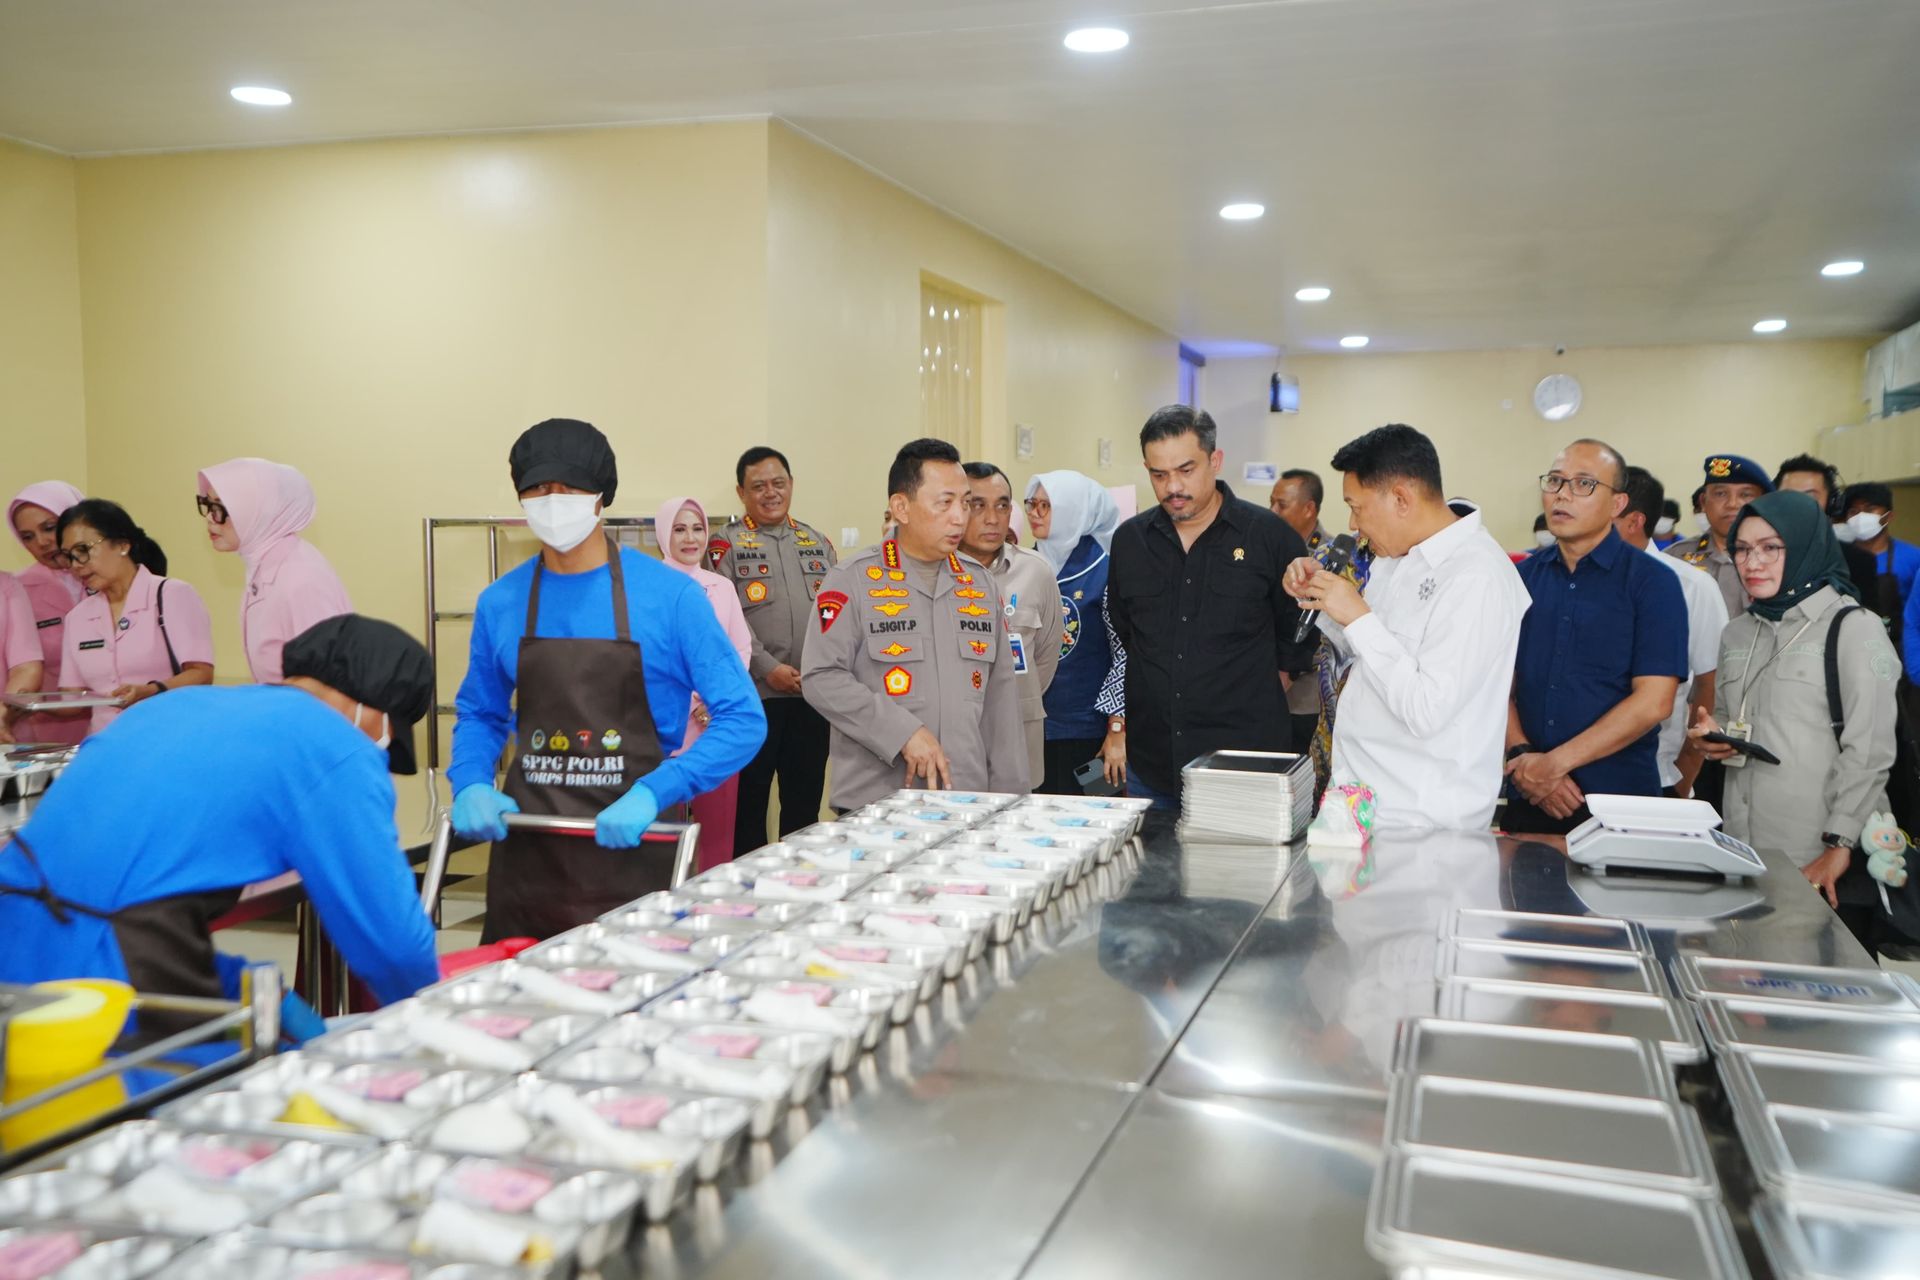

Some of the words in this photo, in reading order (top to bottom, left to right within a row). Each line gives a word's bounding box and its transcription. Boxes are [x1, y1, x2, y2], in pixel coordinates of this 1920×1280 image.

[798, 549, 825, 557] POLRI
[870, 620, 917, 634] L.SIGIT.P
[960, 620, 992, 633] POLRI
[522, 754, 564, 771] SPPG
[566, 755, 625, 772] POLRI
[565, 773, 623, 786] BRIMOB
